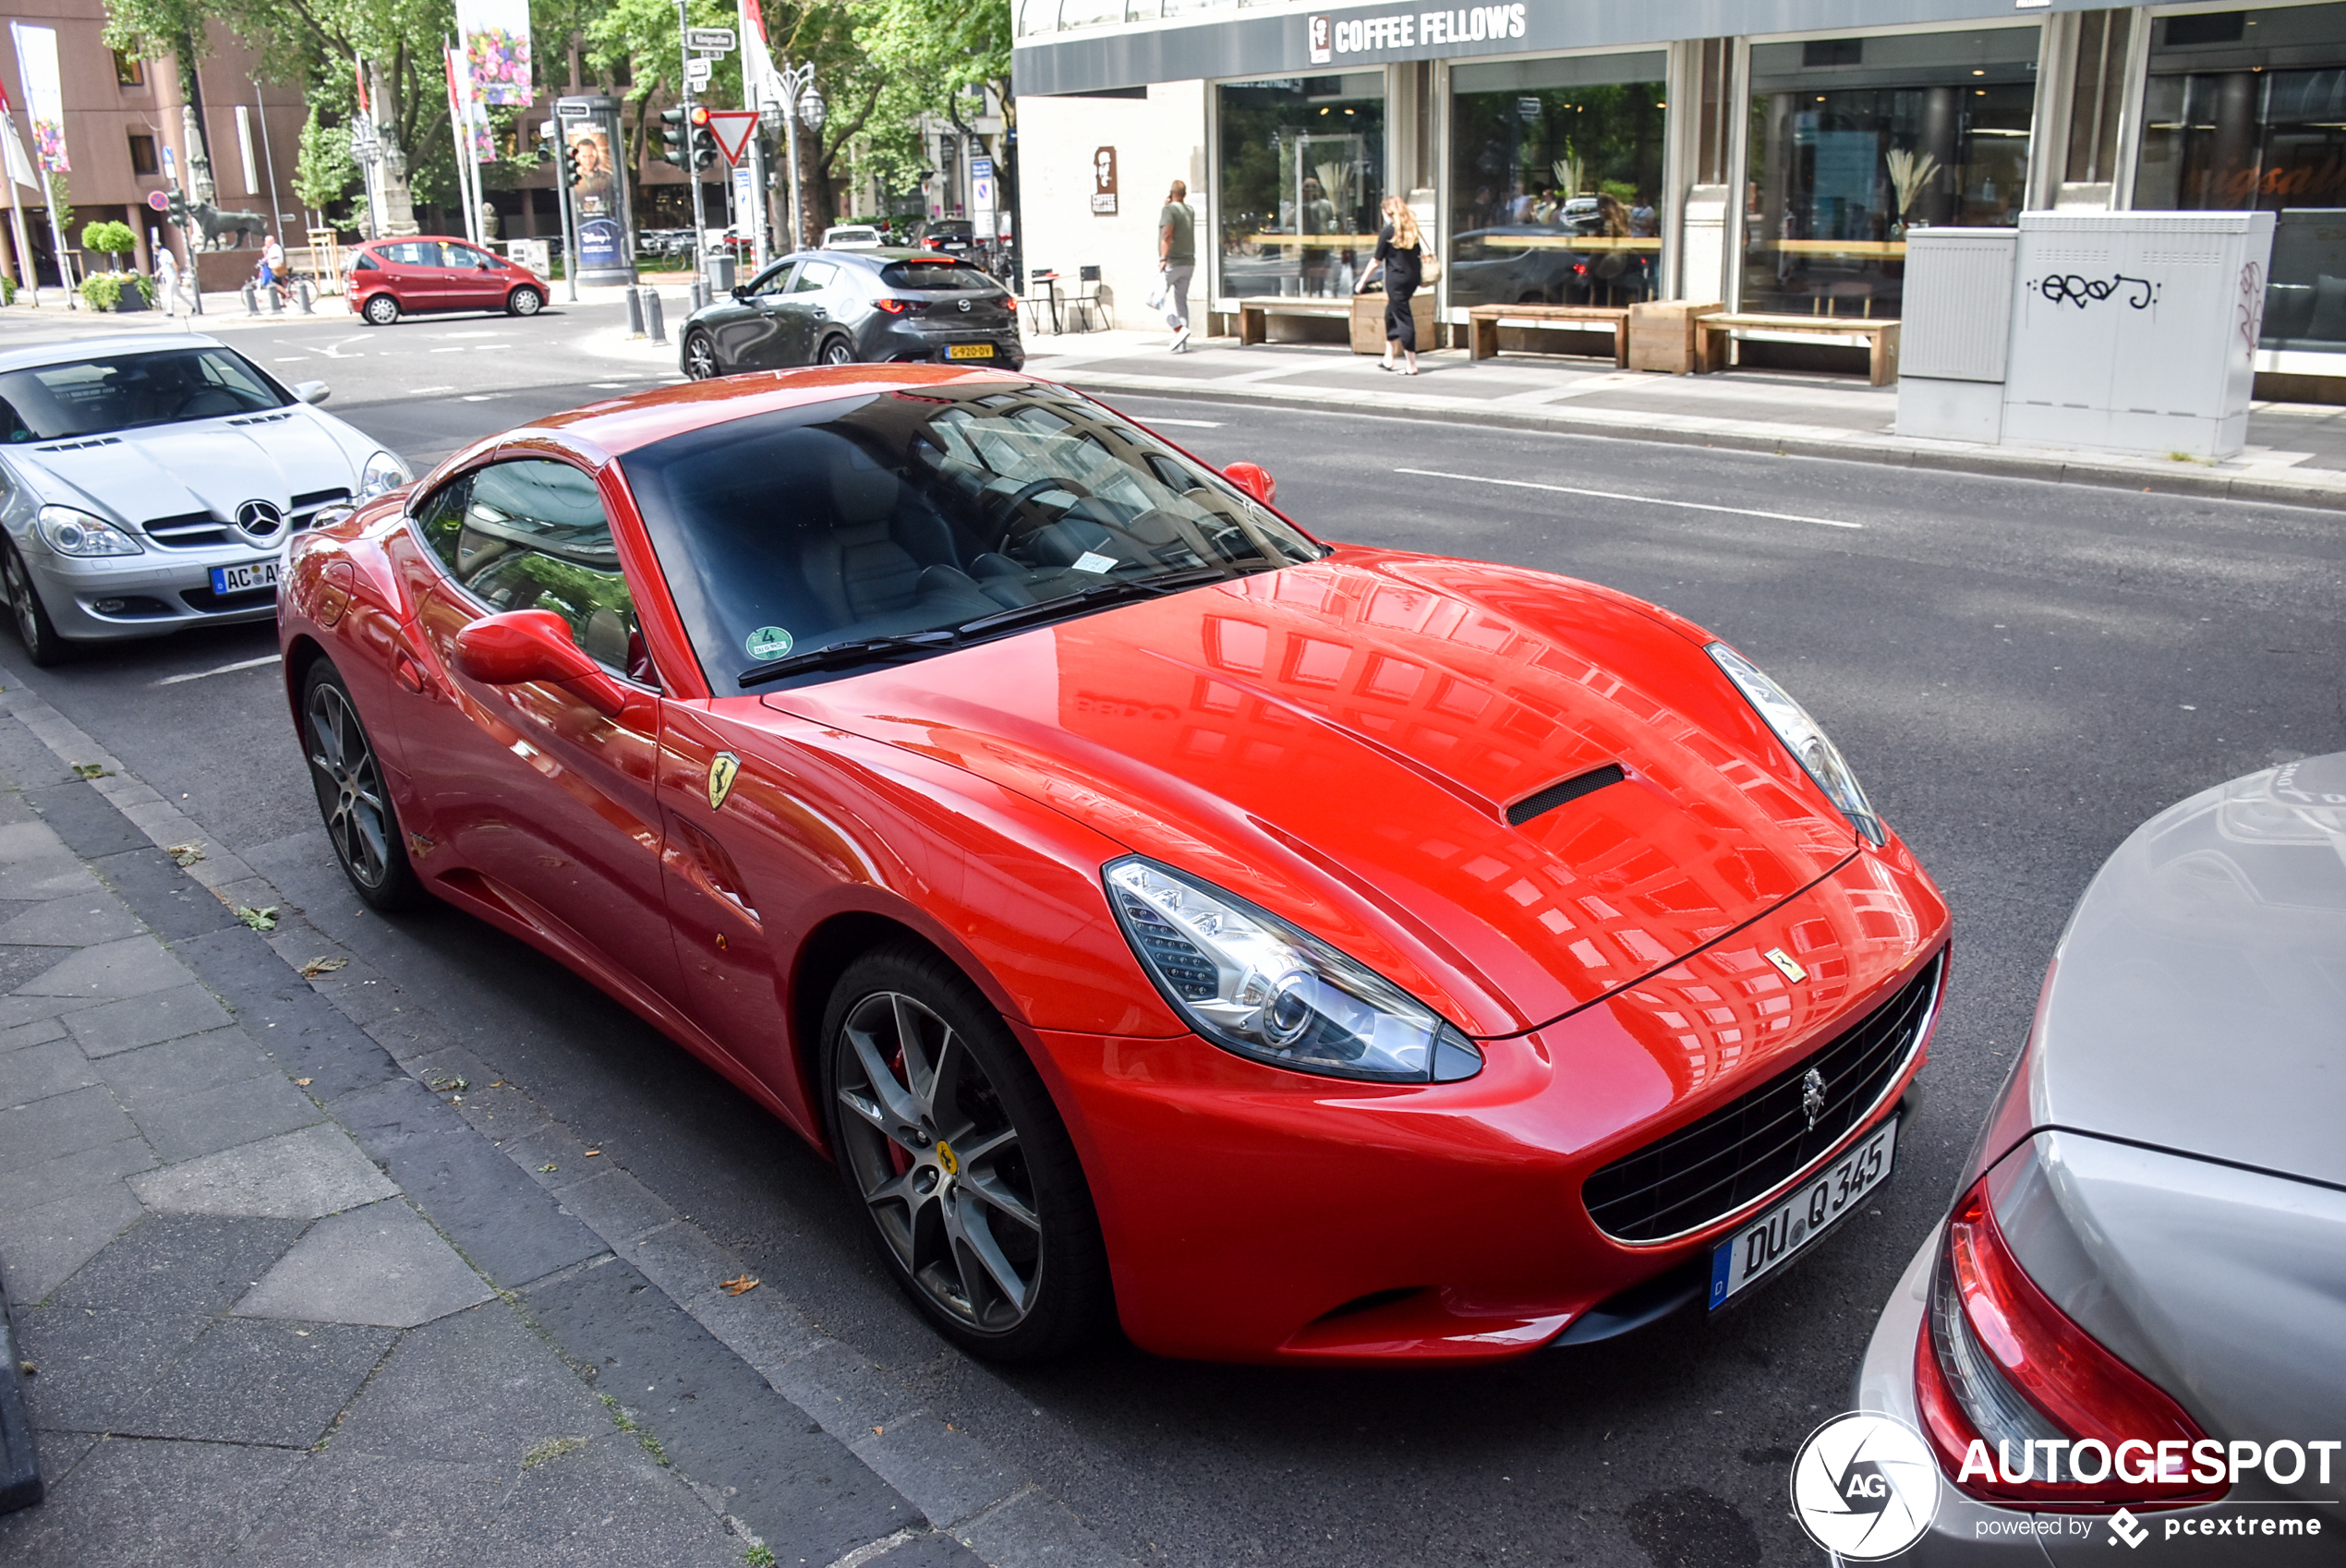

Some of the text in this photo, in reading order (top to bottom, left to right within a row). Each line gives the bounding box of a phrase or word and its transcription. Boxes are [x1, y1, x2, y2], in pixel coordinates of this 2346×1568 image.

[1335, 3, 1526, 54] COFFEE FELLOWS
[1092, 193, 1116, 205] COFFEE
[951, 345, 991, 357] G-920-DV
[228, 563, 280, 589] AC A
[762, 629, 775, 643] 4
[1743, 1132, 1885, 1280] DU Q 345
[1714, 1280, 1723, 1297] D
